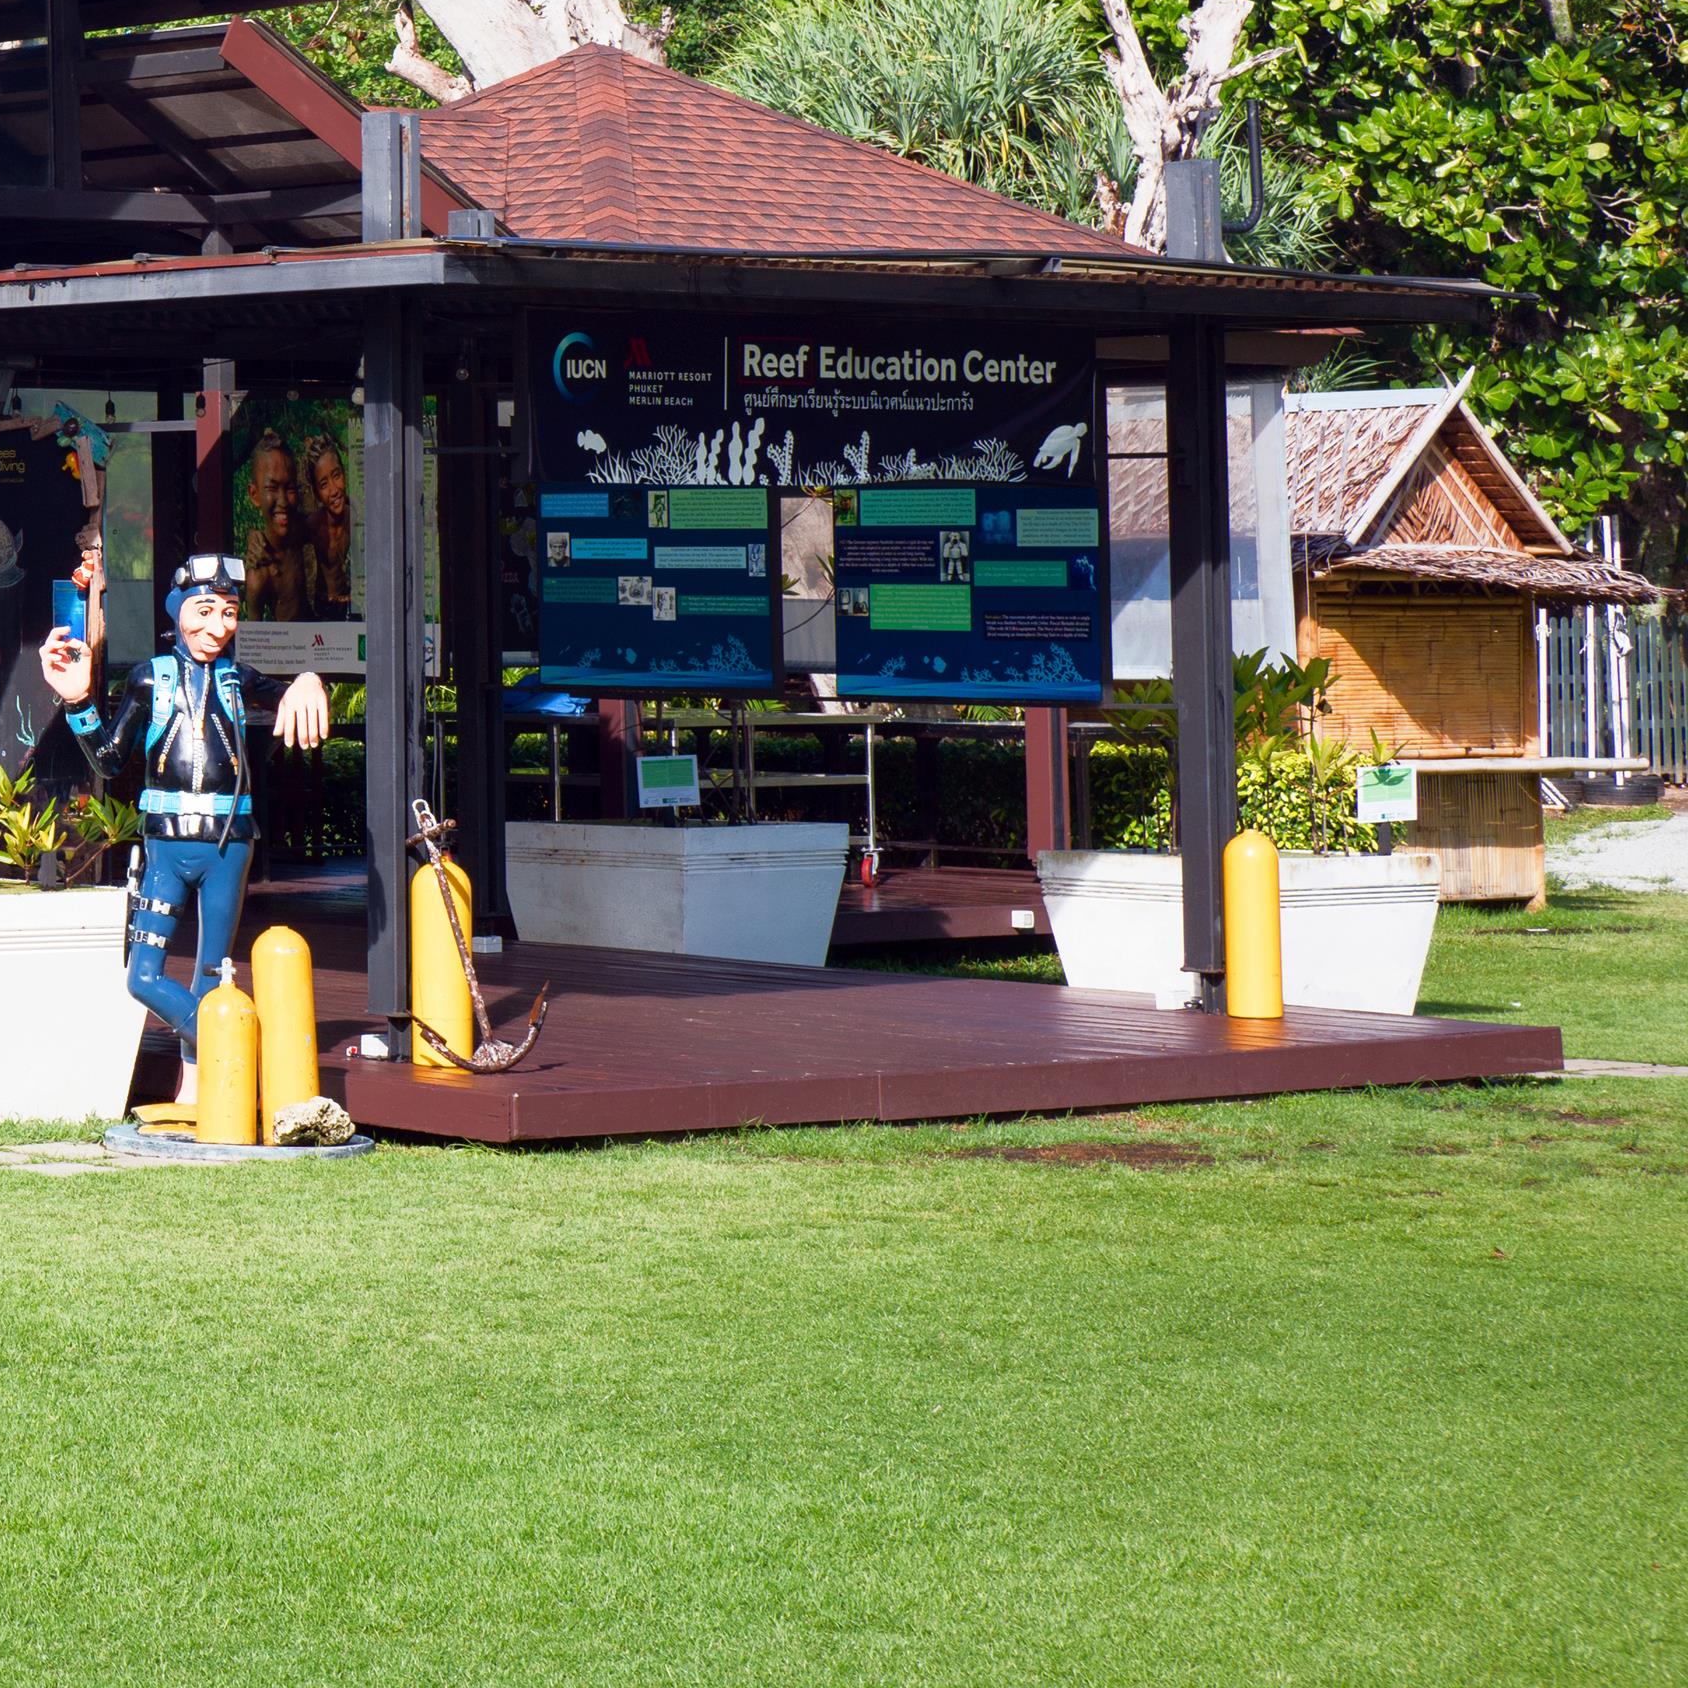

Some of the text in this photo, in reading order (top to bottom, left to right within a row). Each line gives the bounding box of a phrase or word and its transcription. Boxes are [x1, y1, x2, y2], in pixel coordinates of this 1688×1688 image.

[566, 359, 606, 379] IUCN
[744, 344, 1056, 385] Reef Education Center
[629, 371, 713, 382] MARRIOTT RESORT
[629, 384, 663, 394] PHUKET
[629, 396, 694, 406] MERLIN BEACH
